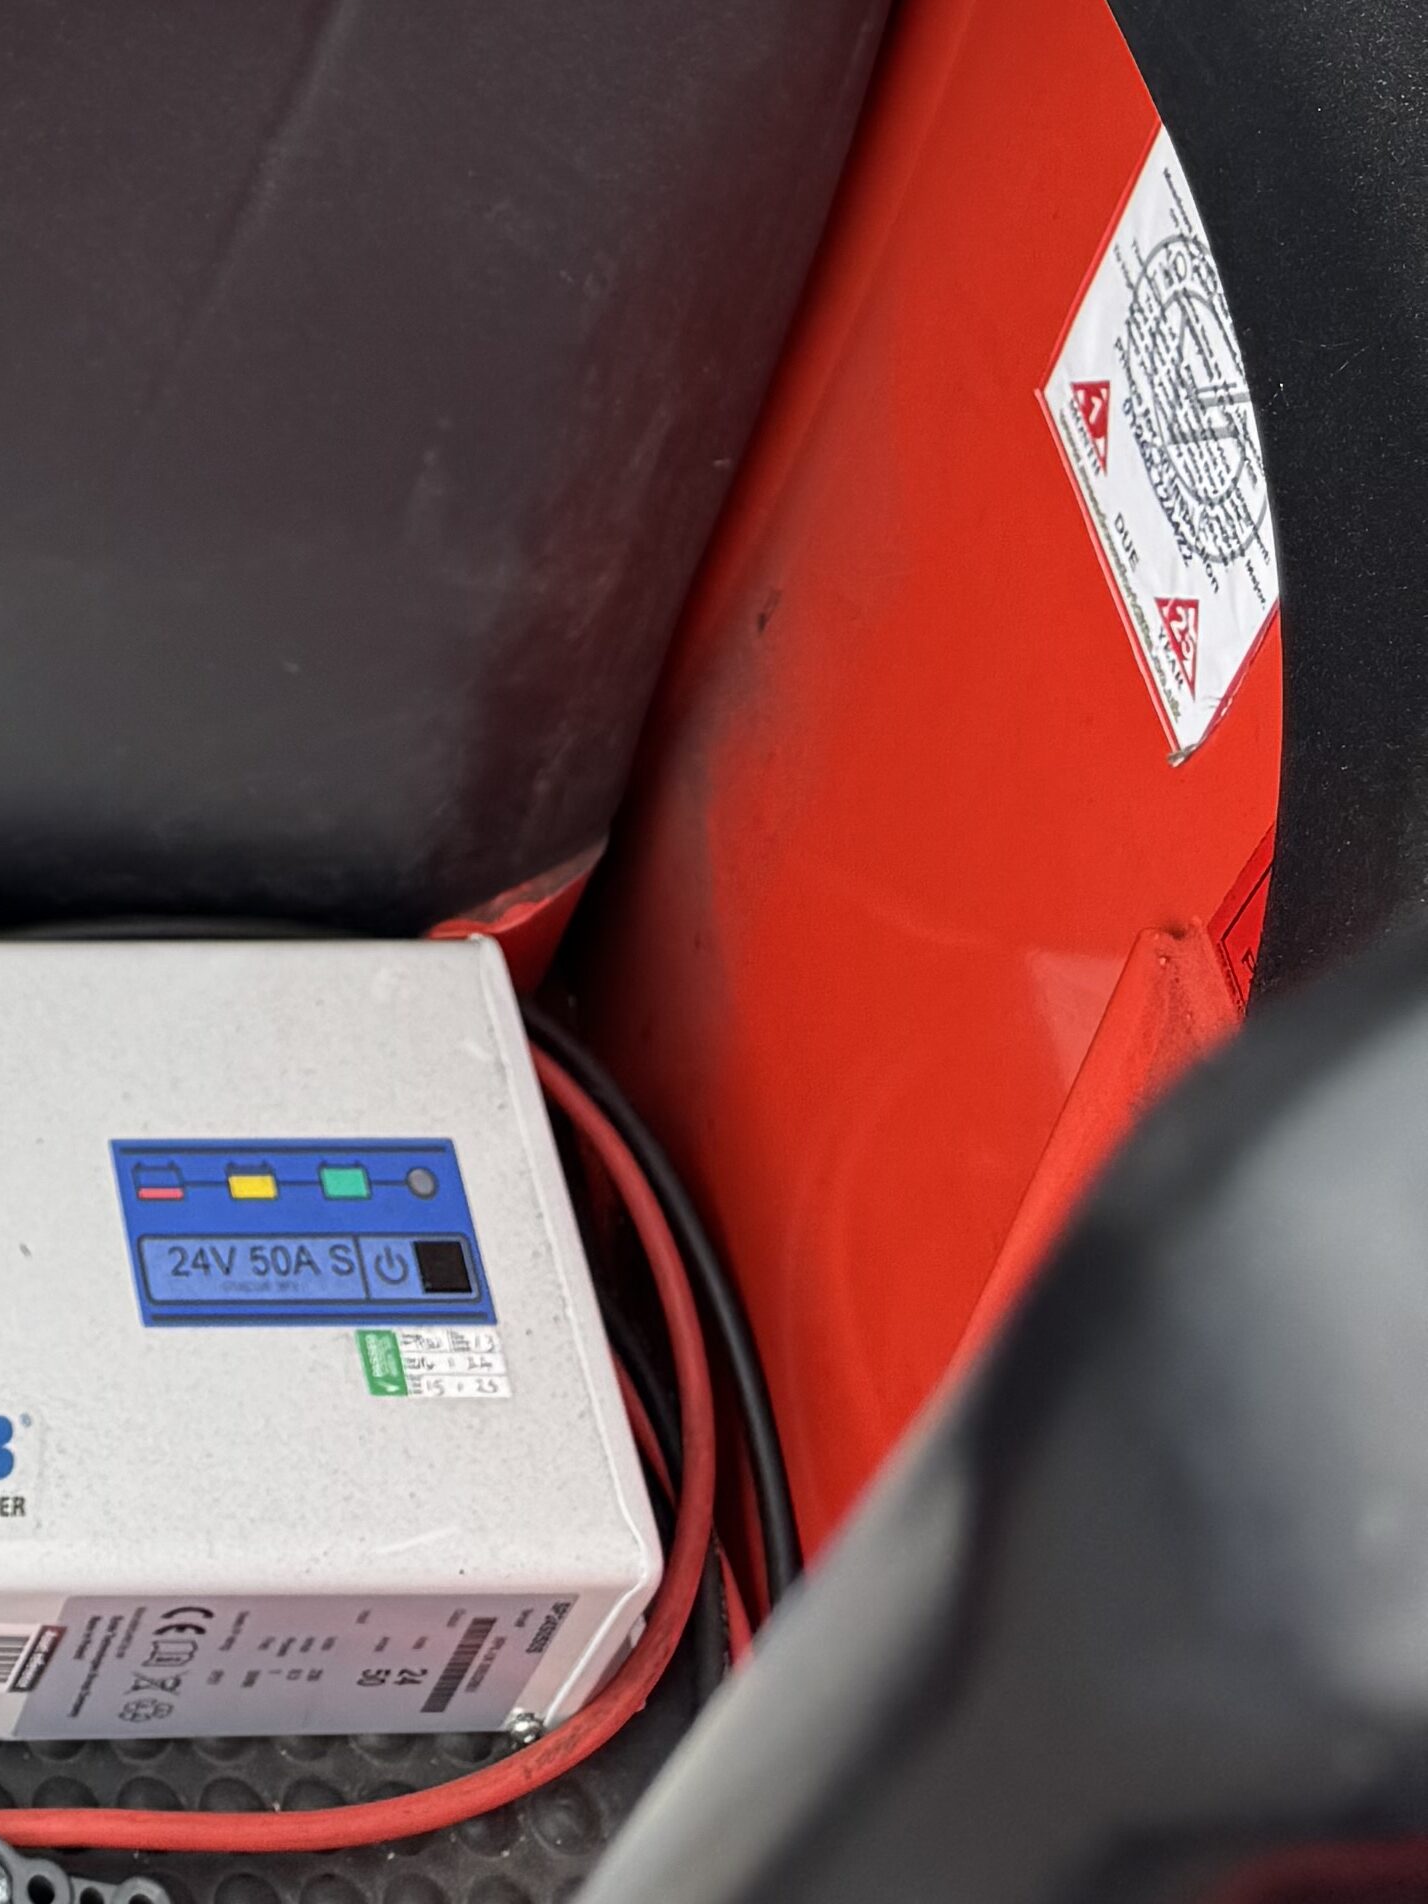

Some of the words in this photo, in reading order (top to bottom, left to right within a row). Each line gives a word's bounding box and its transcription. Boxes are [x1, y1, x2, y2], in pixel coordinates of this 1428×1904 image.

[1113, 511, 1140, 573] DUE
[168, 1246, 237, 1277] 24V
[249, 1245, 322, 1277] 50A
[328, 1244, 356, 1277] S
